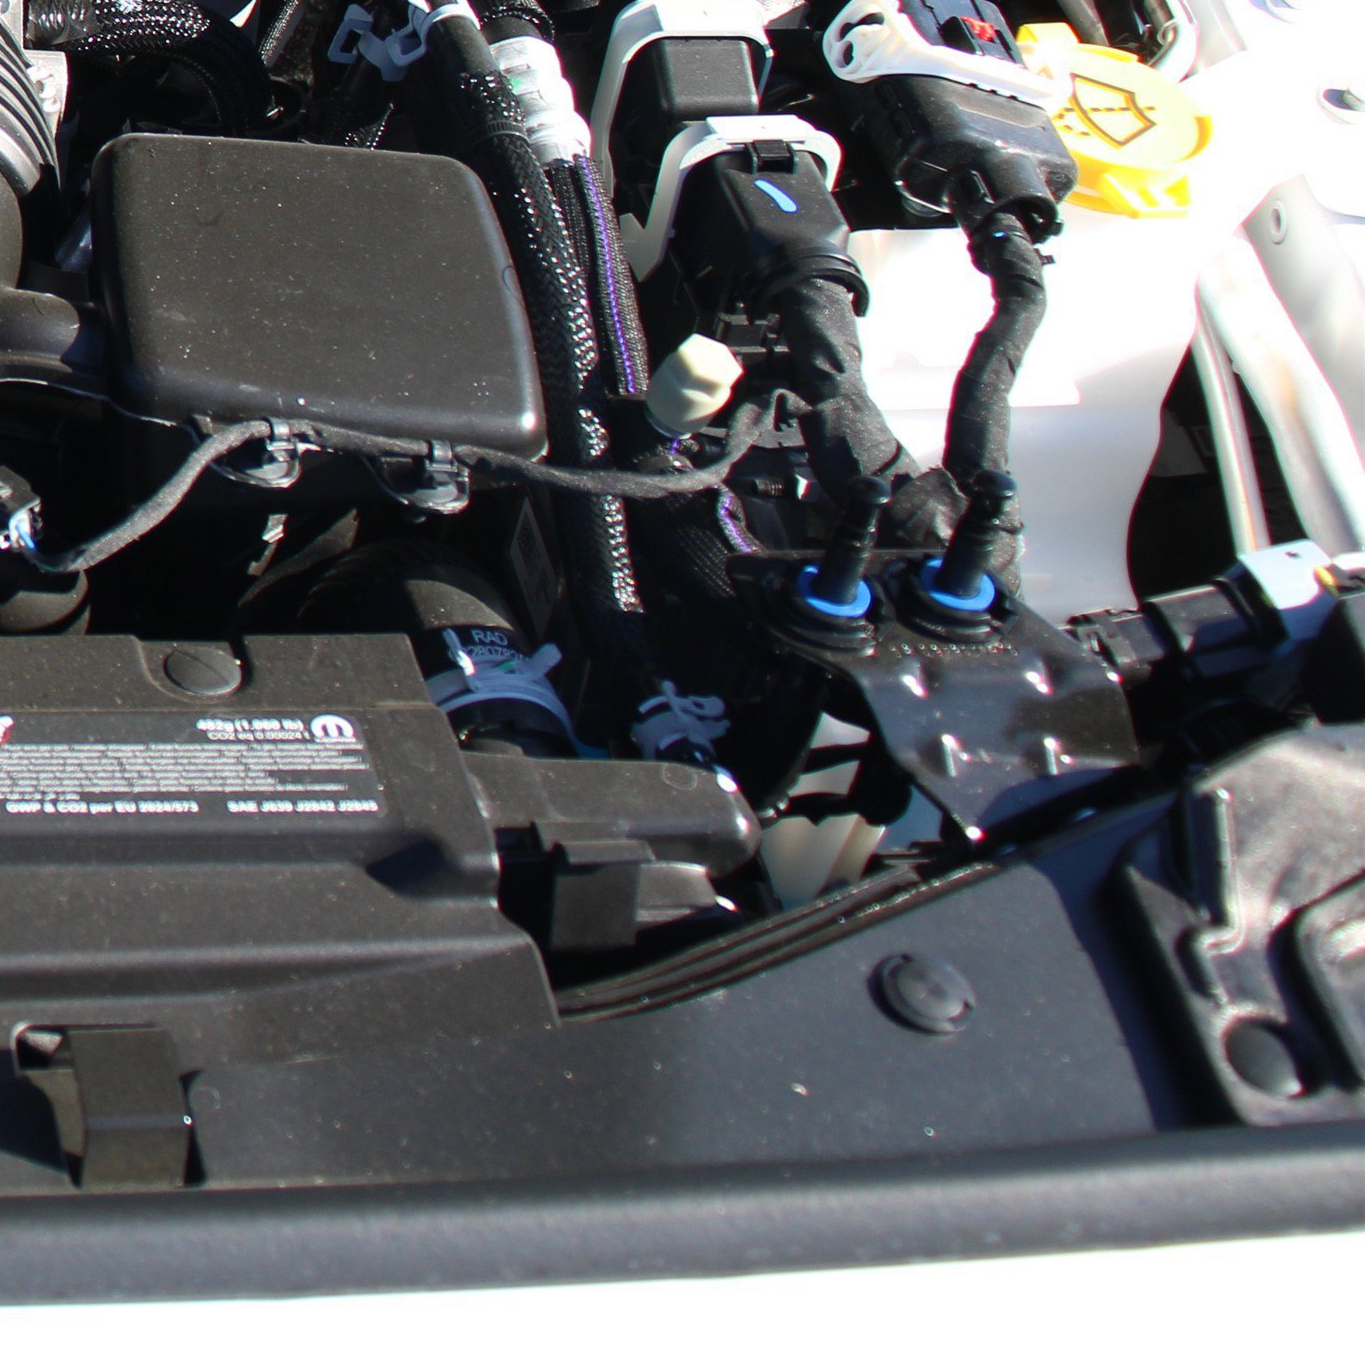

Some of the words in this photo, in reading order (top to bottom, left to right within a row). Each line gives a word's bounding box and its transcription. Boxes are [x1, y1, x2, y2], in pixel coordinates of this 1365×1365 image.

[471, 629, 508, 646] RAD
[207, 731, 236, 741] CO2
[5, 801, 41, 813] GWP
[43, 801, 55, 813] &
[56, 801, 88, 813] CO2
[89, 802, 113, 815] per
[114, 800, 137, 813] EU
[137, 800, 200, 813] 2024/573
[226, 800, 258, 813] SAE
[260, 800, 293, 813] J639
